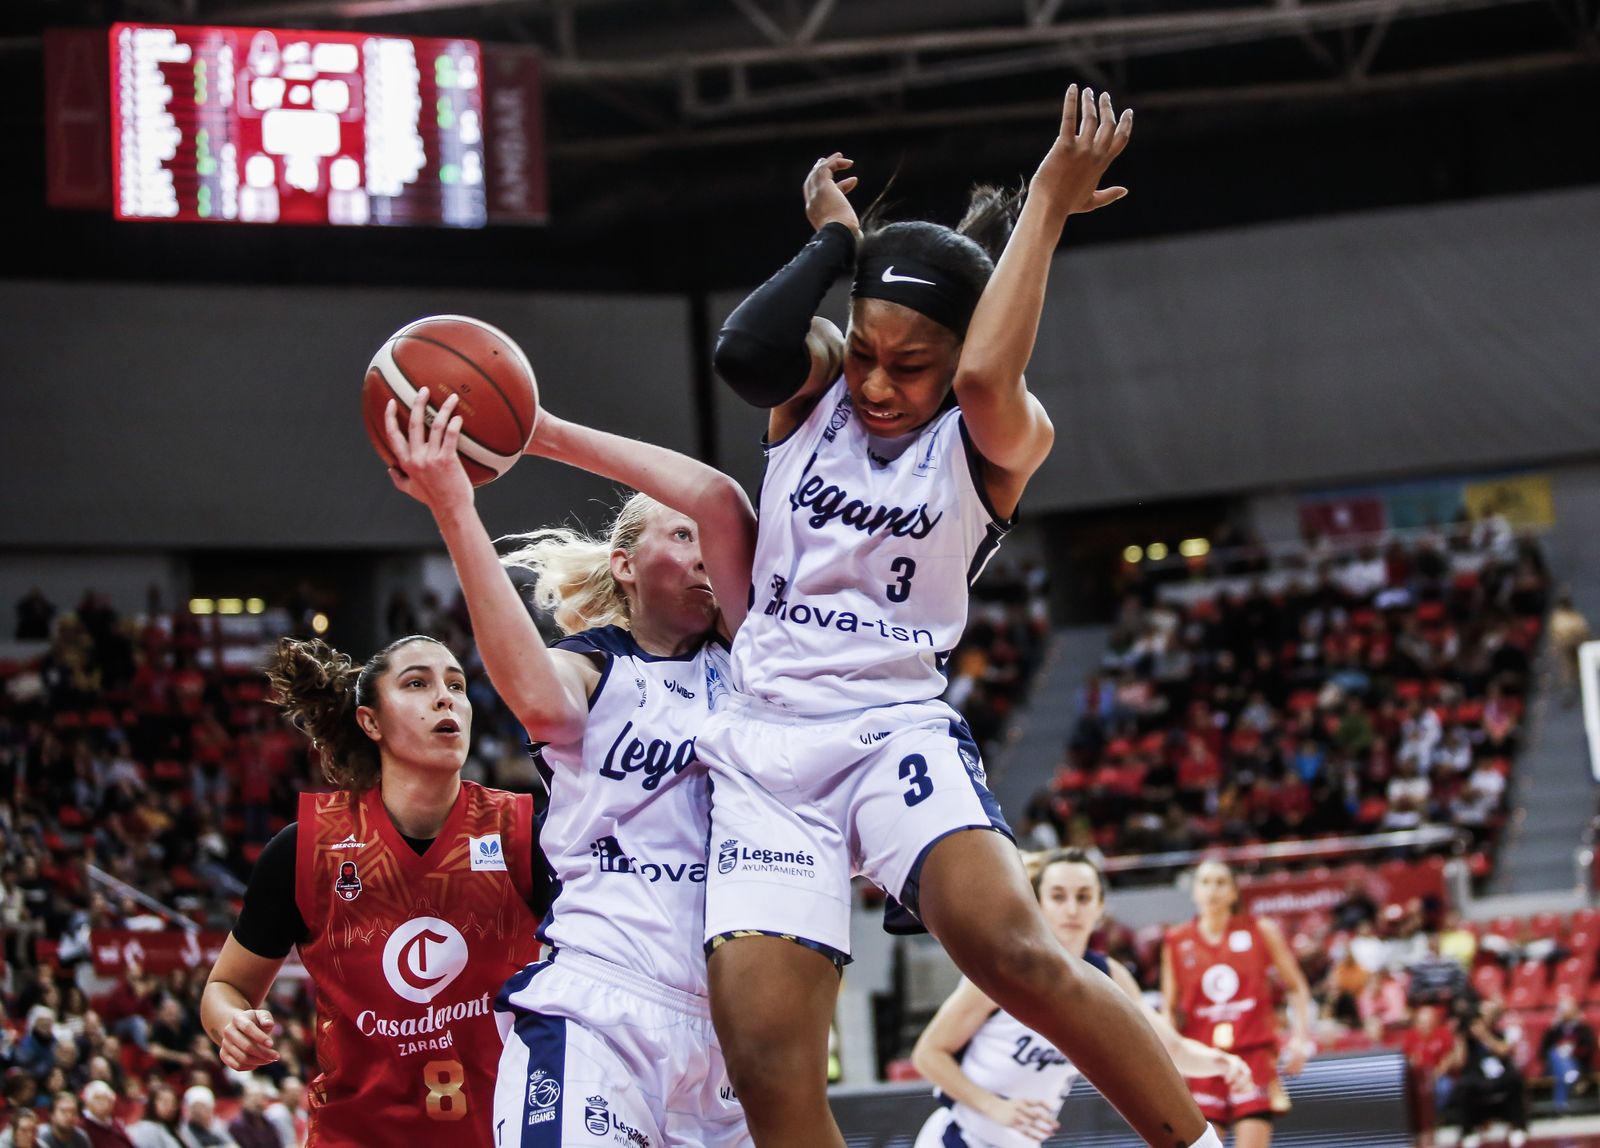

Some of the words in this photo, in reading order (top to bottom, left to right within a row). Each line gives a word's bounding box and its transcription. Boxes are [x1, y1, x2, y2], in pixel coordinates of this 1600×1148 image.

[886, 556, 916, 603] 3
[898, 753, 934, 807] 3
[332, 842, 366, 850] MERCURY
[742, 847, 814, 866] Leganés
[742, 864, 815, 879] AYUNTAMIENTO
[423, 1060, 467, 1121] 8
